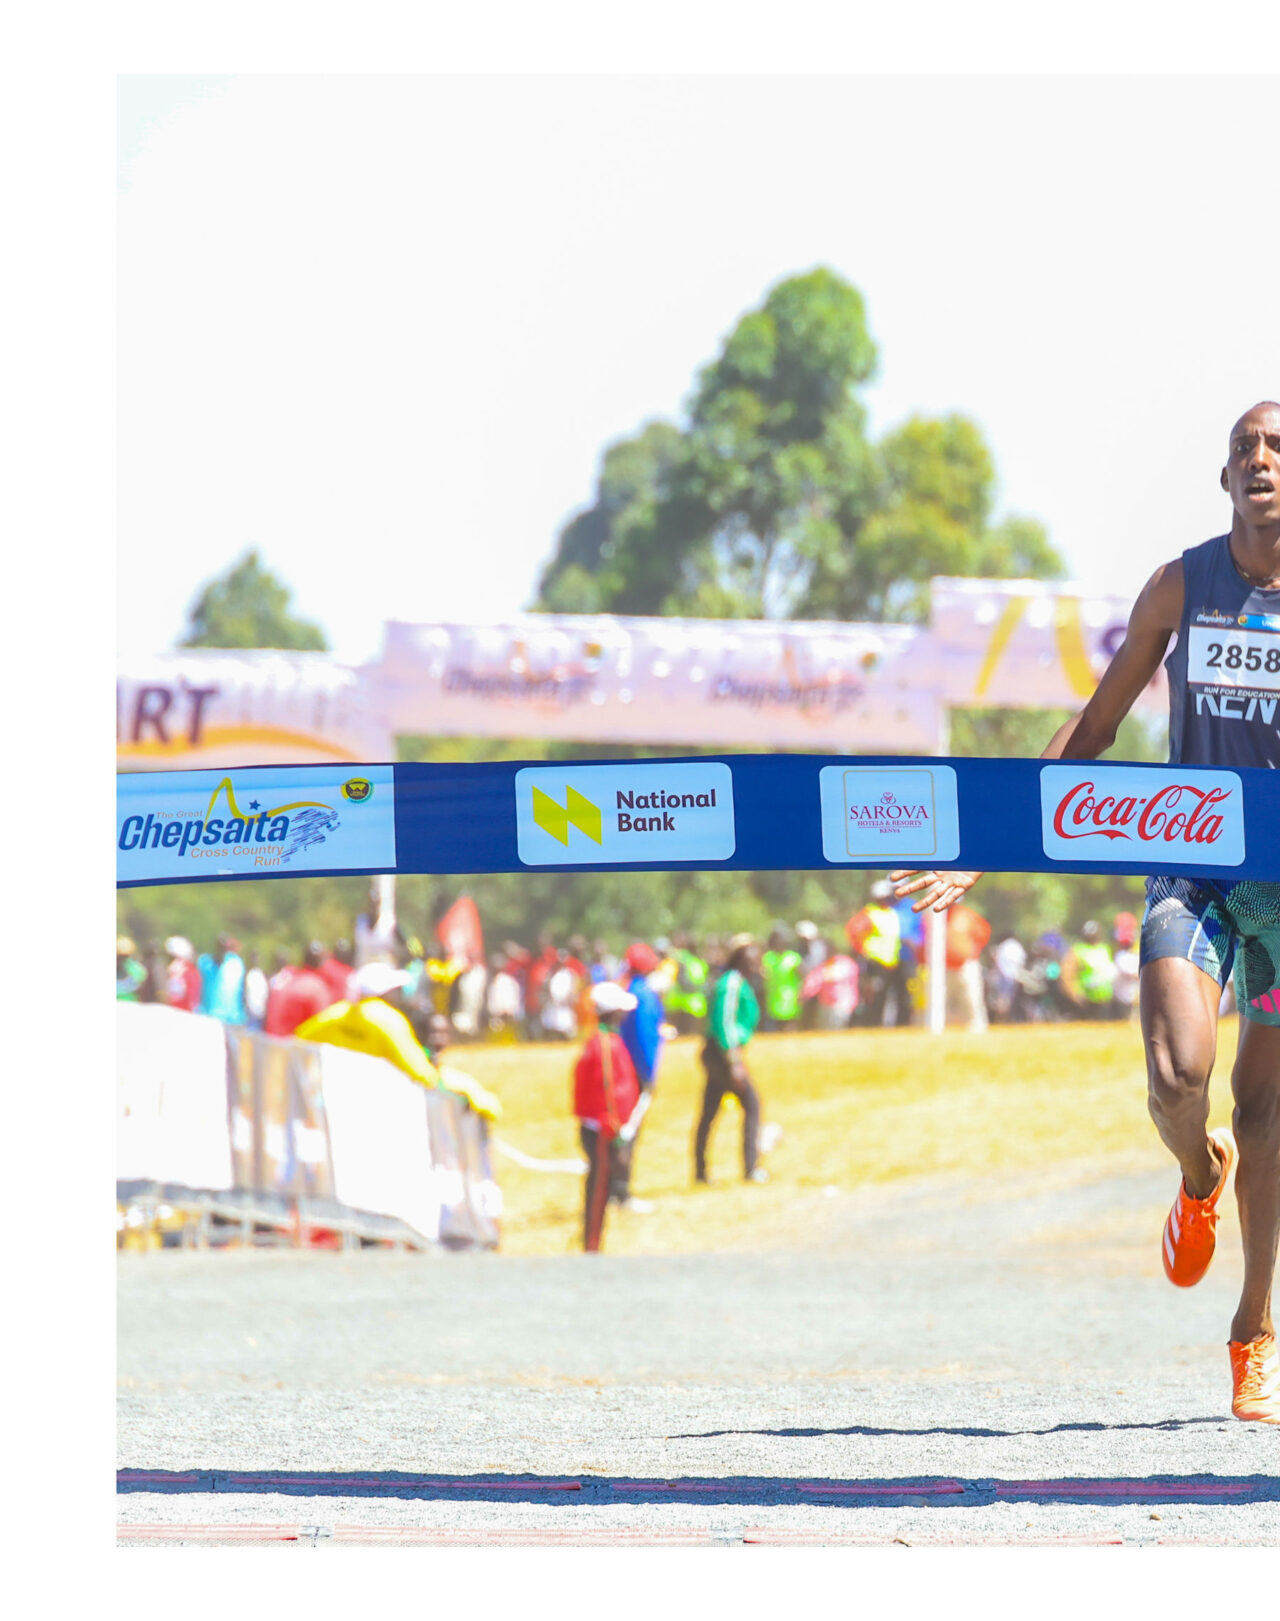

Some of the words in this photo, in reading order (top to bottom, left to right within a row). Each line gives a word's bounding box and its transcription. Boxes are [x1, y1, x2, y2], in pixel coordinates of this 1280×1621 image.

[1203, 686, 1219, 694] RUN
[1220, 687, 1236, 696] FOR
[1237, 689, 1280, 699] EDUCATION
[117, 685, 219, 746] RT
[616, 789, 717, 810] National
[156, 811, 174, 819] The
[177, 809, 203, 818] Great
[850, 805, 929, 820] SAROVA
[1053, 781, 1234, 844] Coca-Cola
[617, 812, 676, 832] Bank
[118, 811, 290, 856] Chepsaita
[191, 847, 229, 859] Cross
[233, 845, 284, 857] Country
[254, 856, 281, 867] Run
